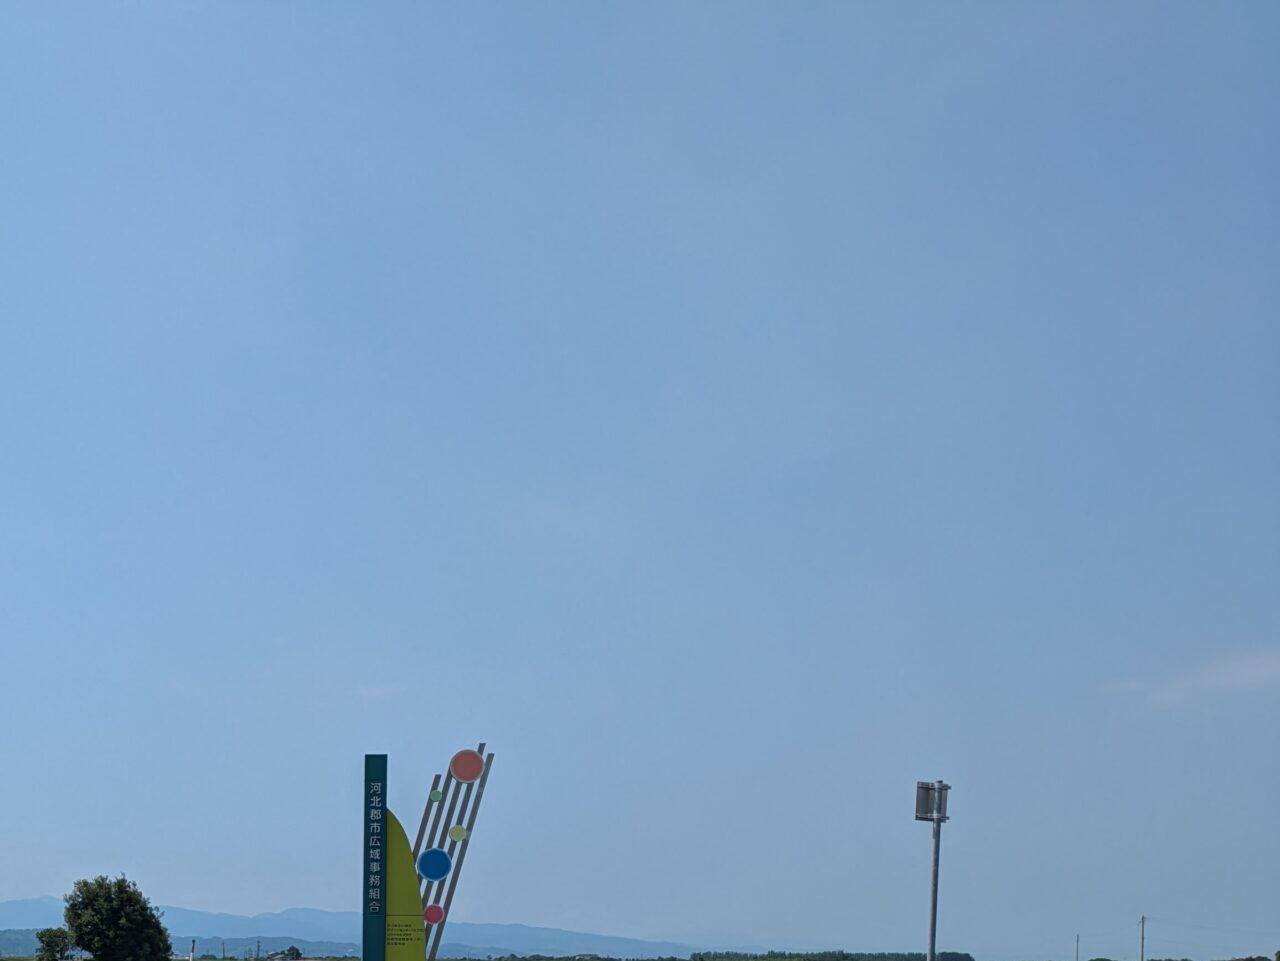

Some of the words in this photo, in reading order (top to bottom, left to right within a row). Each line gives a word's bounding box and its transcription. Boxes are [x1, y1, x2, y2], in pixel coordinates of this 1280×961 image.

[369, 782, 382, 912] 河北郡市広域事務組合
